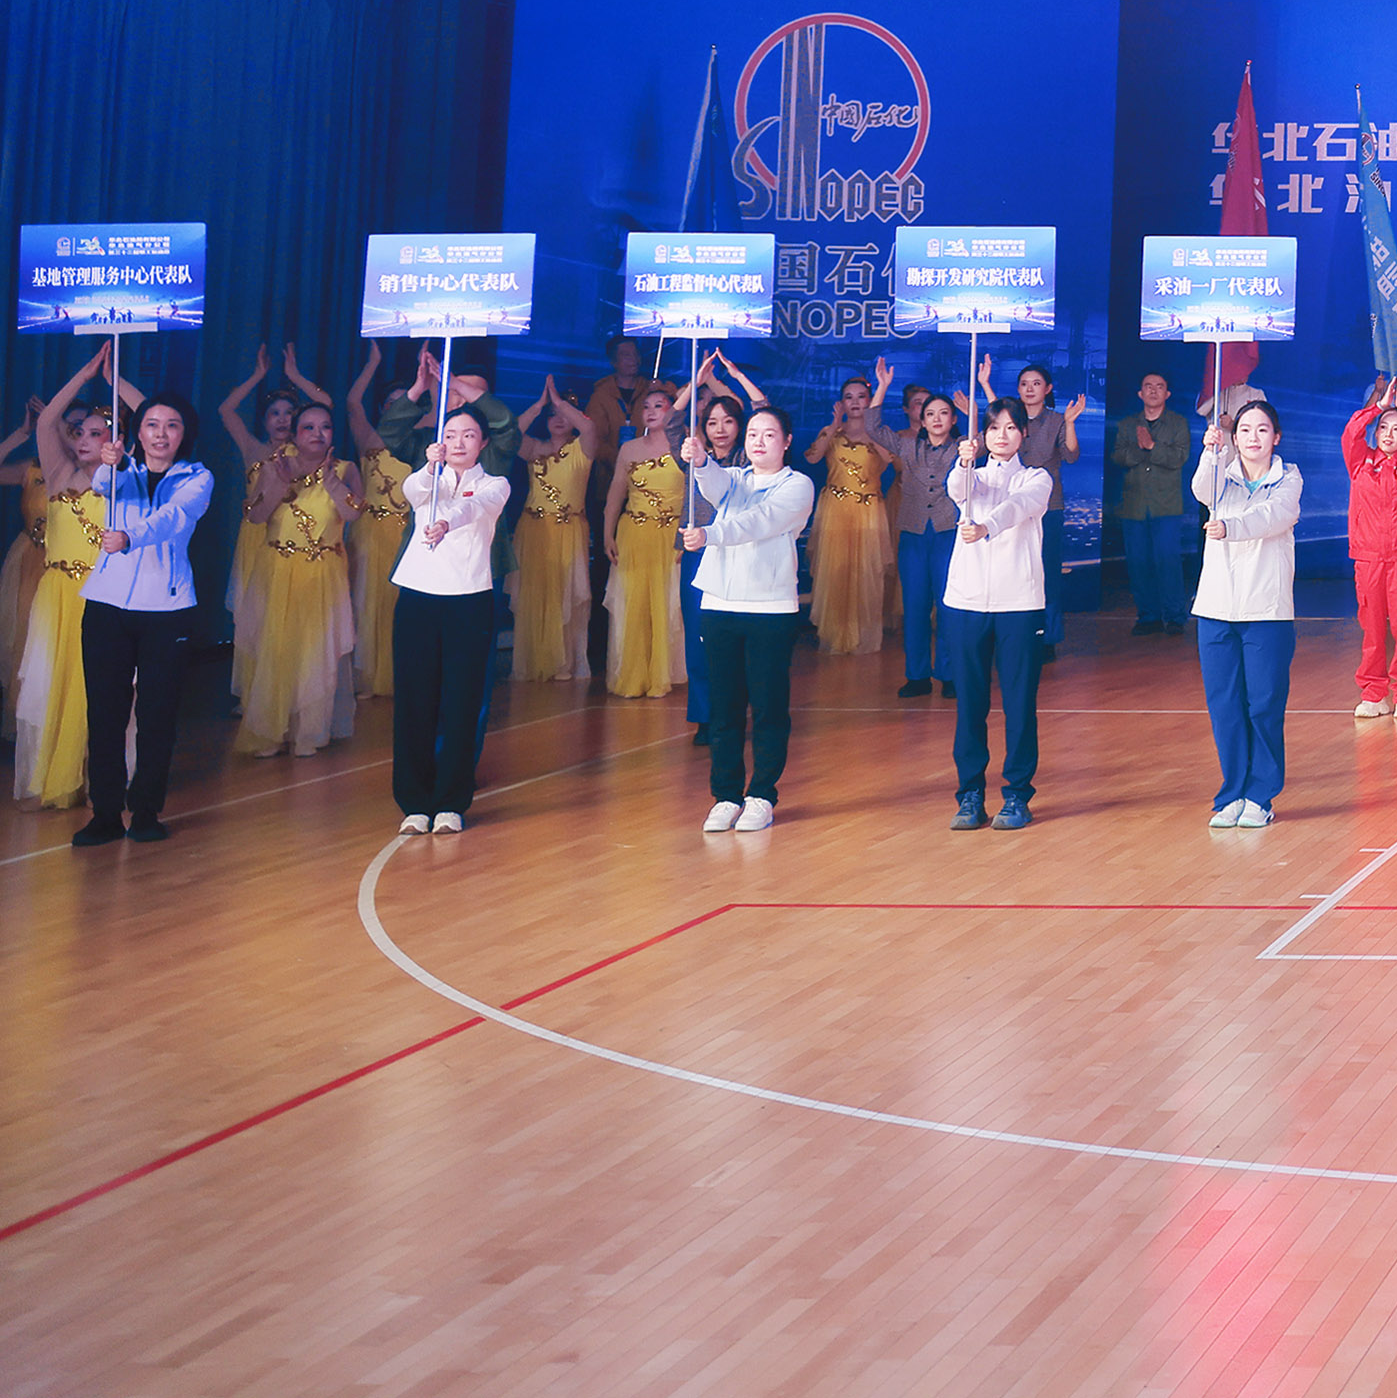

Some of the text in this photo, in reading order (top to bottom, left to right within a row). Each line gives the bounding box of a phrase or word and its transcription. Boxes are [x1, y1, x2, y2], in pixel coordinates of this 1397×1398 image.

[32, 265, 192, 287] 基地管理服务中心代表队
[379, 272, 519, 293] 销售中心代表队
[1154, 276, 1283, 296] 采油一厂代表队
